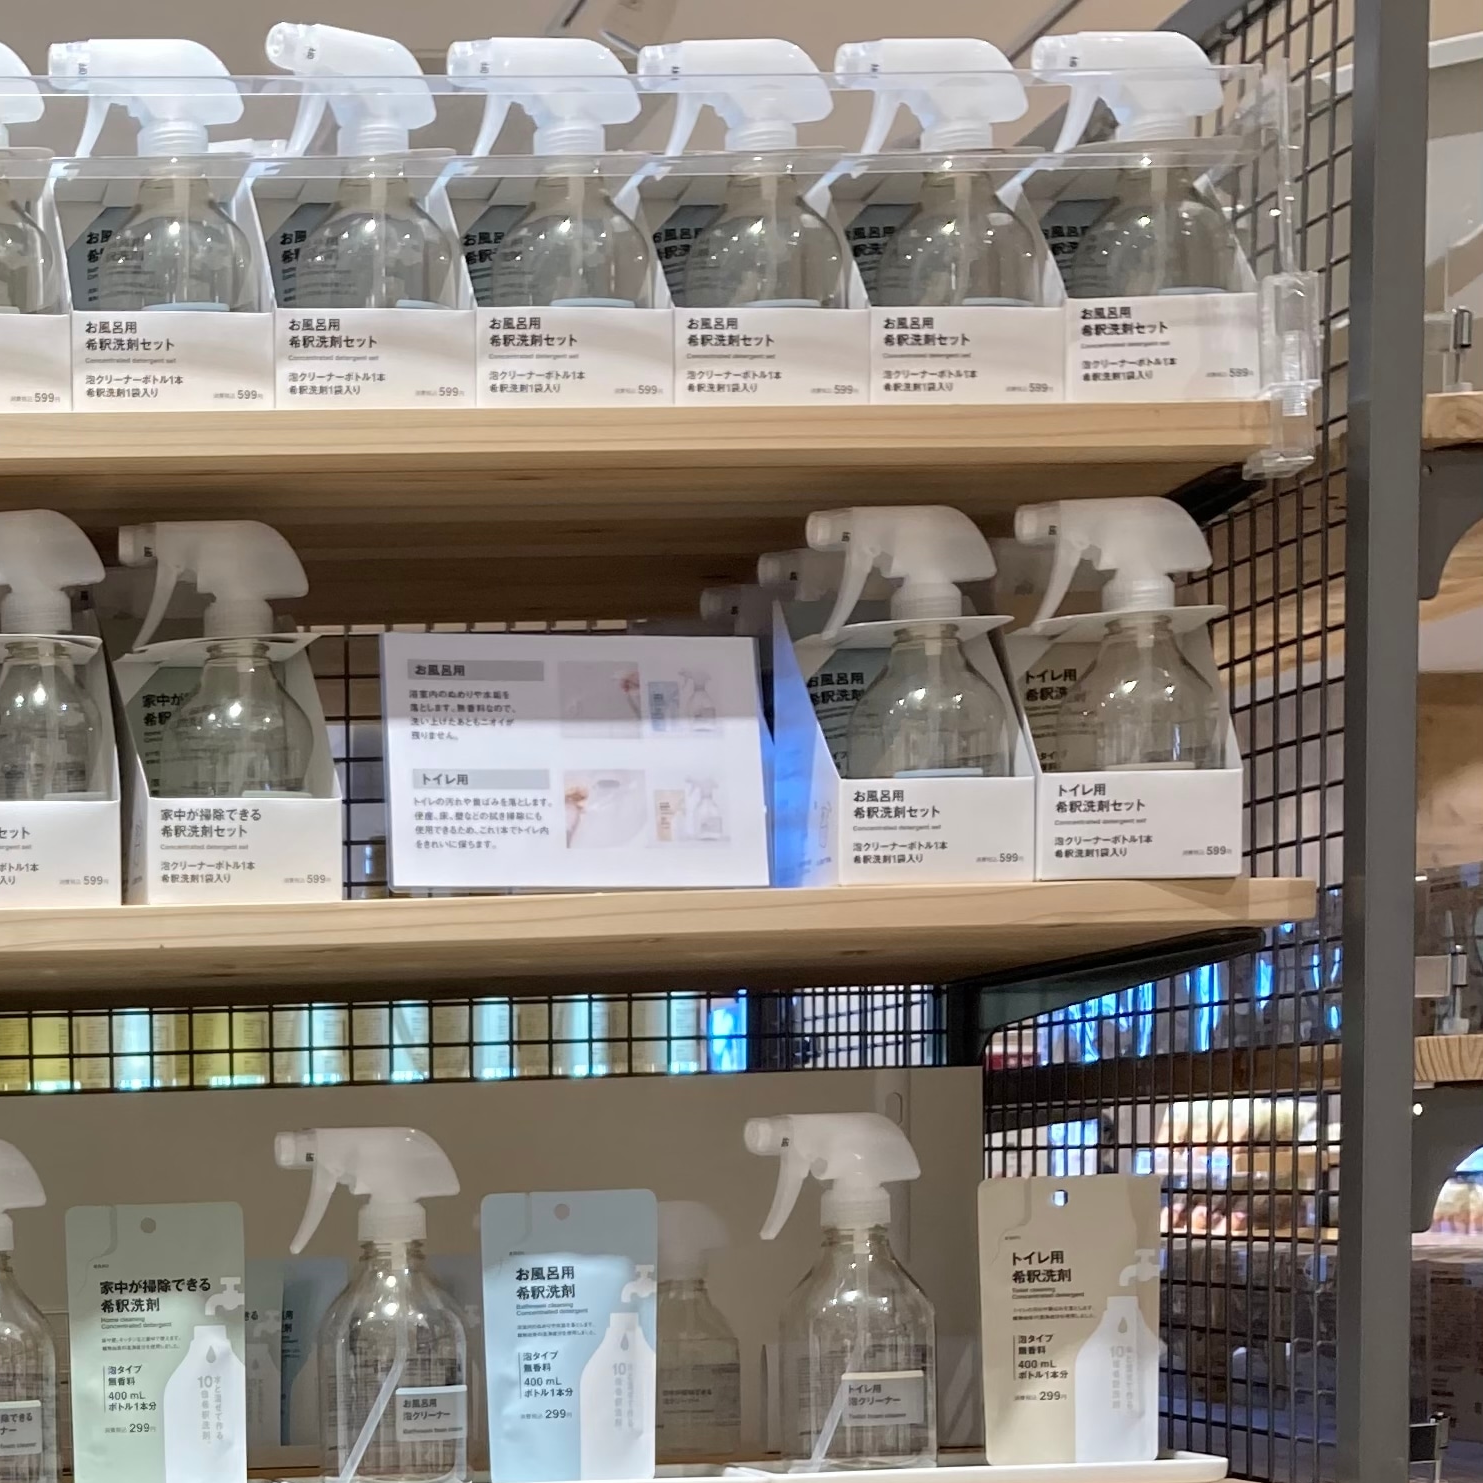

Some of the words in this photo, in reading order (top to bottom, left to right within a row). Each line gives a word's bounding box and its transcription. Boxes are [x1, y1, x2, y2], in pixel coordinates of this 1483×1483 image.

[1081, 307, 1131, 320] お風呂用
[85, 321, 137, 334] お風呂用
[289, 318, 340, 331] お風呂用
[489, 317, 541, 330] お風呂用
[687, 317, 738, 330] お風呂用
[883, 317, 934, 330] お風呂用
[1081, 321, 1168, 336] 希釈洗剤セット
[85, 337, 175, 352] 希釈洗剤セット
[489, 334, 577, 348] 希釈洗剤セット
[883, 333, 970, 347] 希釈洗剤セット
[415, 664, 466, 677] お風呂用
[422, 774, 469, 786] トイレ用
[853, 790, 904, 803] お風呂用
[1057, 784, 1106, 797] トイレ用
[853, 805, 940, 819] 希釈洗剤セット
[1056, 799, 1145, 814] 希釈洗剤セット
[160, 809, 262, 822] 家中が掃除できる
[160, 825, 248, 838] 希釈洗剤セット
[1012, 1250, 1064, 1264] トイレ用
[515, 1265, 575, 1281] お風呂用
[1012, 1268, 1071, 1283] 希釈洗剤
[100, 1278, 211, 1294] 家中が掃除できる
[516, 1284, 576, 1300] 希釈洗剤
[100, 1297, 160, 1312] 希釈洗剤
[523, 1351, 558, 1361] 泡タイプ
[524, 1387, 574, 1398] ボトル1本分
[848, 1384, 881, 1394] トイレ用
[848, 1396, 901, 1407] 泡クリーナー
[403, 1410, 450, 1421] 泡クリーナー
